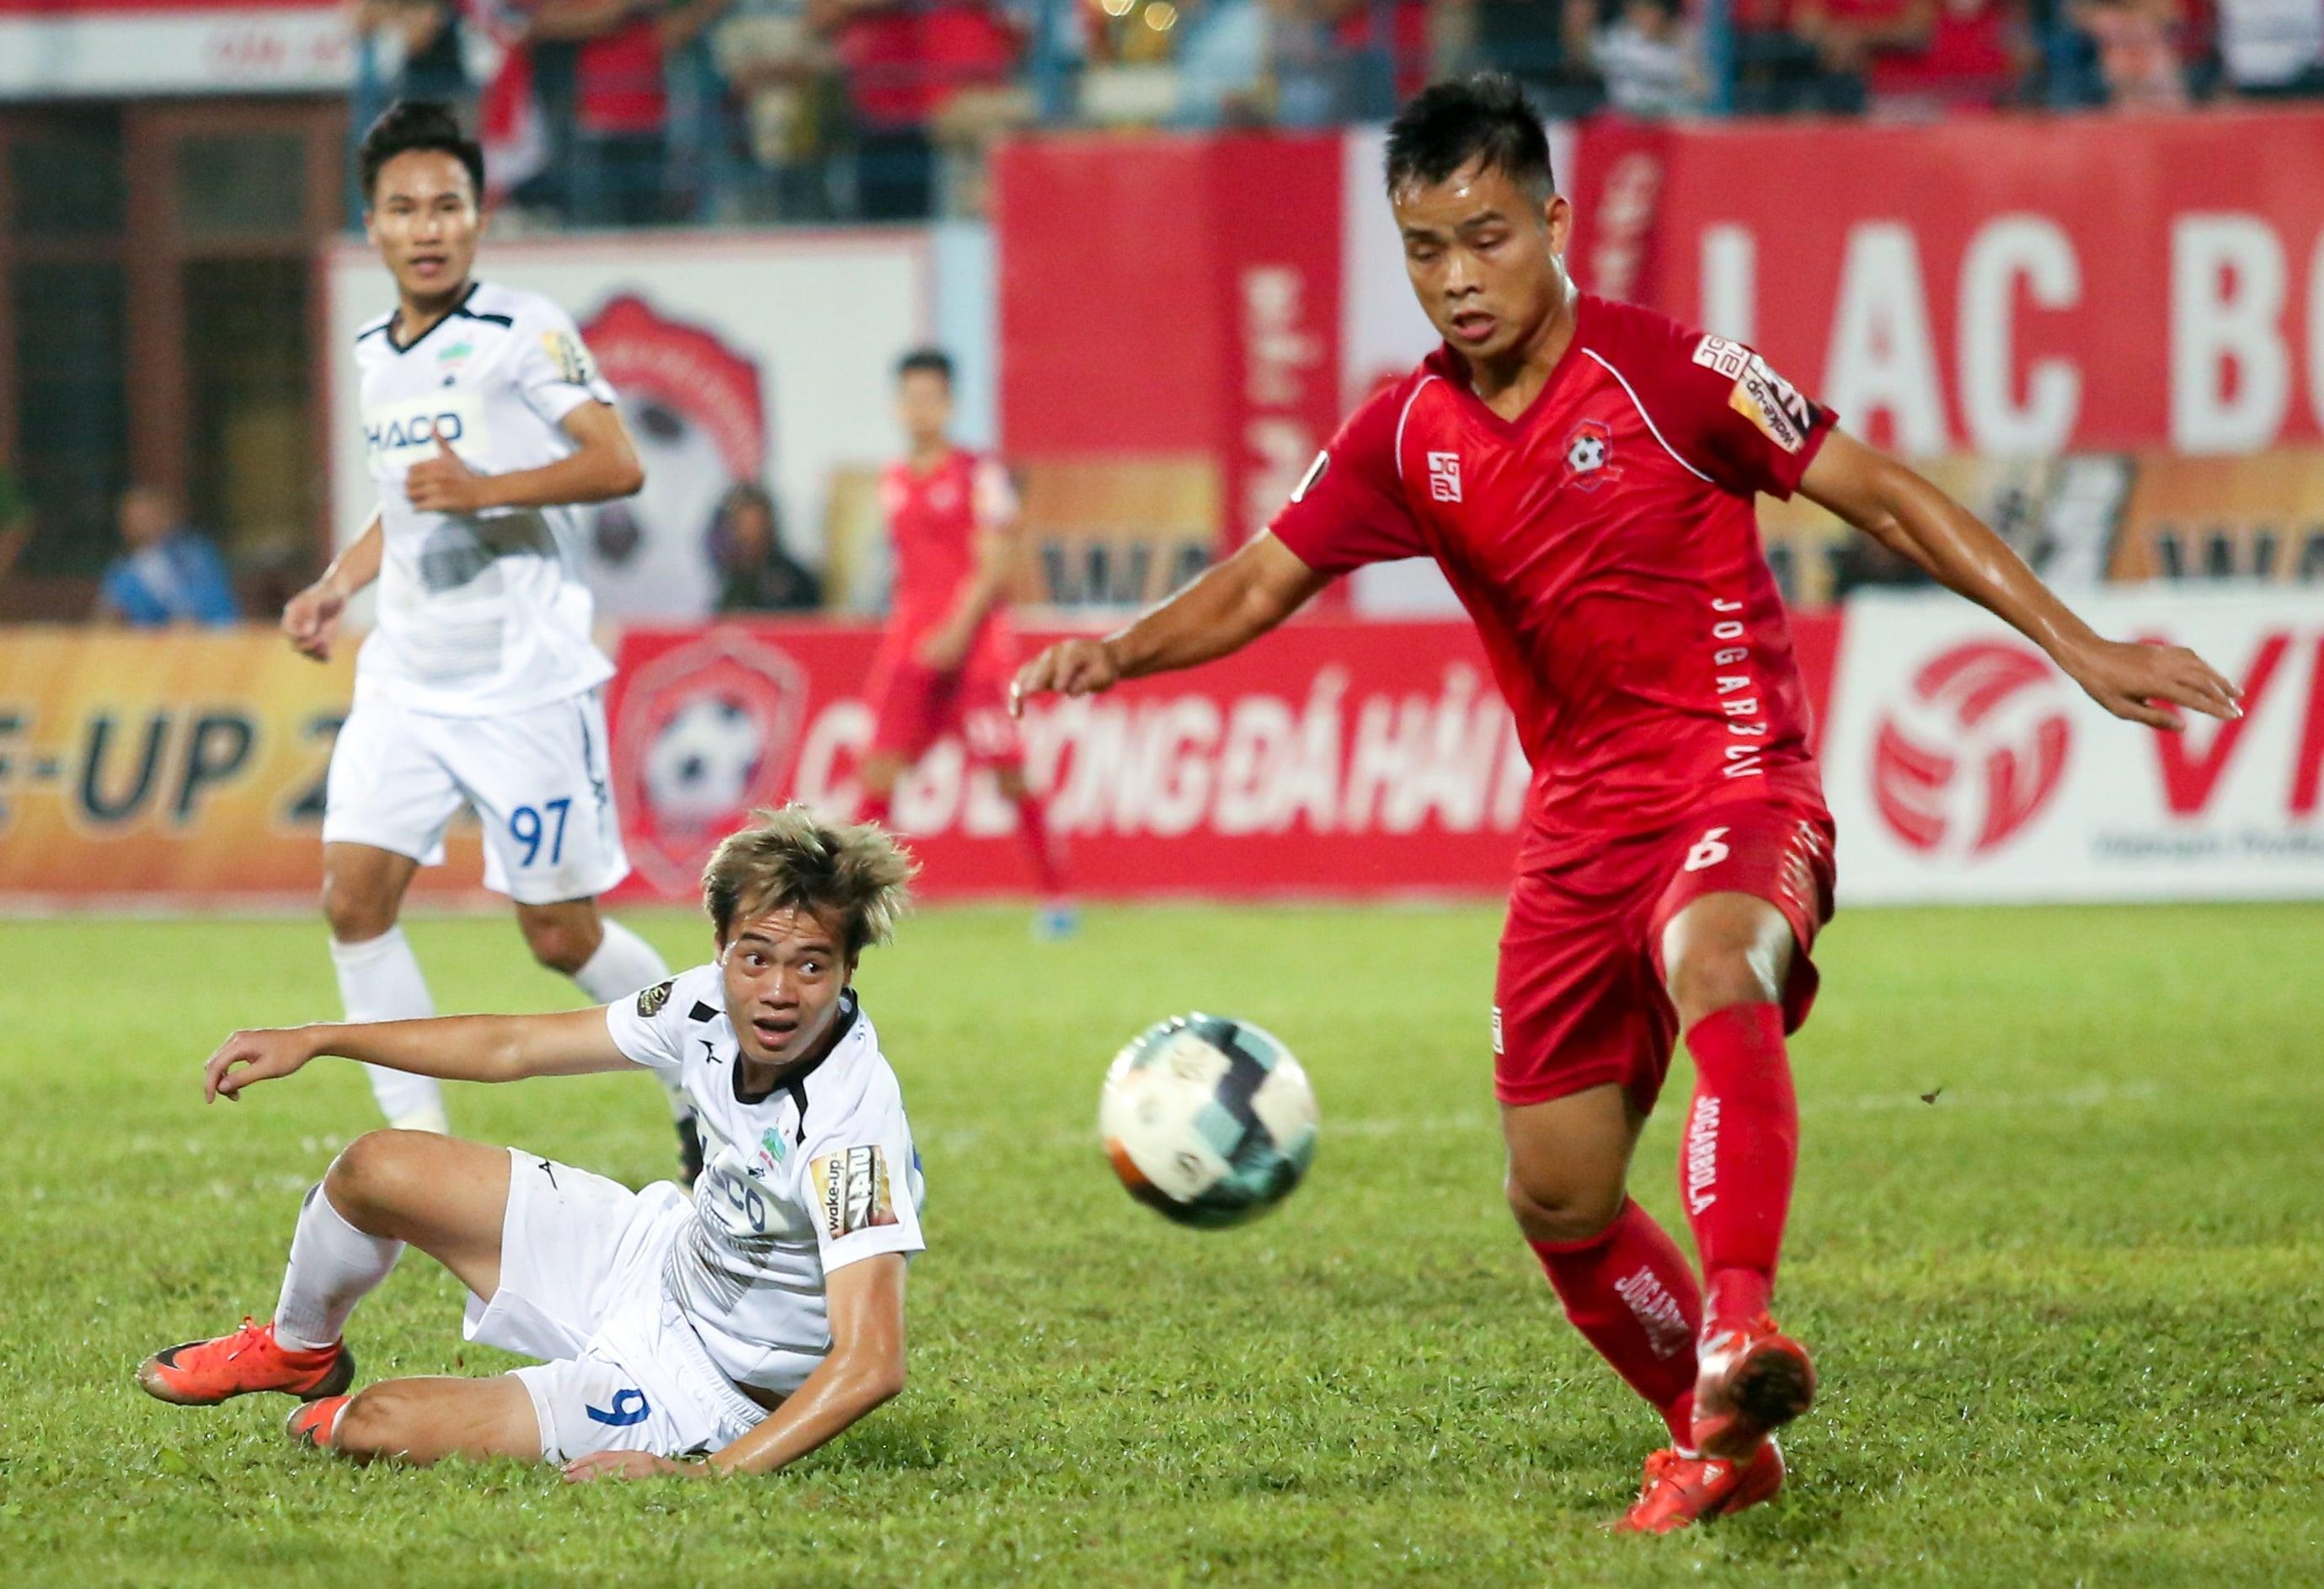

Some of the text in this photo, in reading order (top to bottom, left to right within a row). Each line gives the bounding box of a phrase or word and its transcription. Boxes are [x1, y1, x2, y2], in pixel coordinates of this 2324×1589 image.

[2168, 211, 2324, 457] B
[1746, 380, 1794, 448] wake-up
[510, 798, 572, 867] 97
[1684, 826, 1731, 872] 6
[825, 1160, 846, 1233] wake-up
